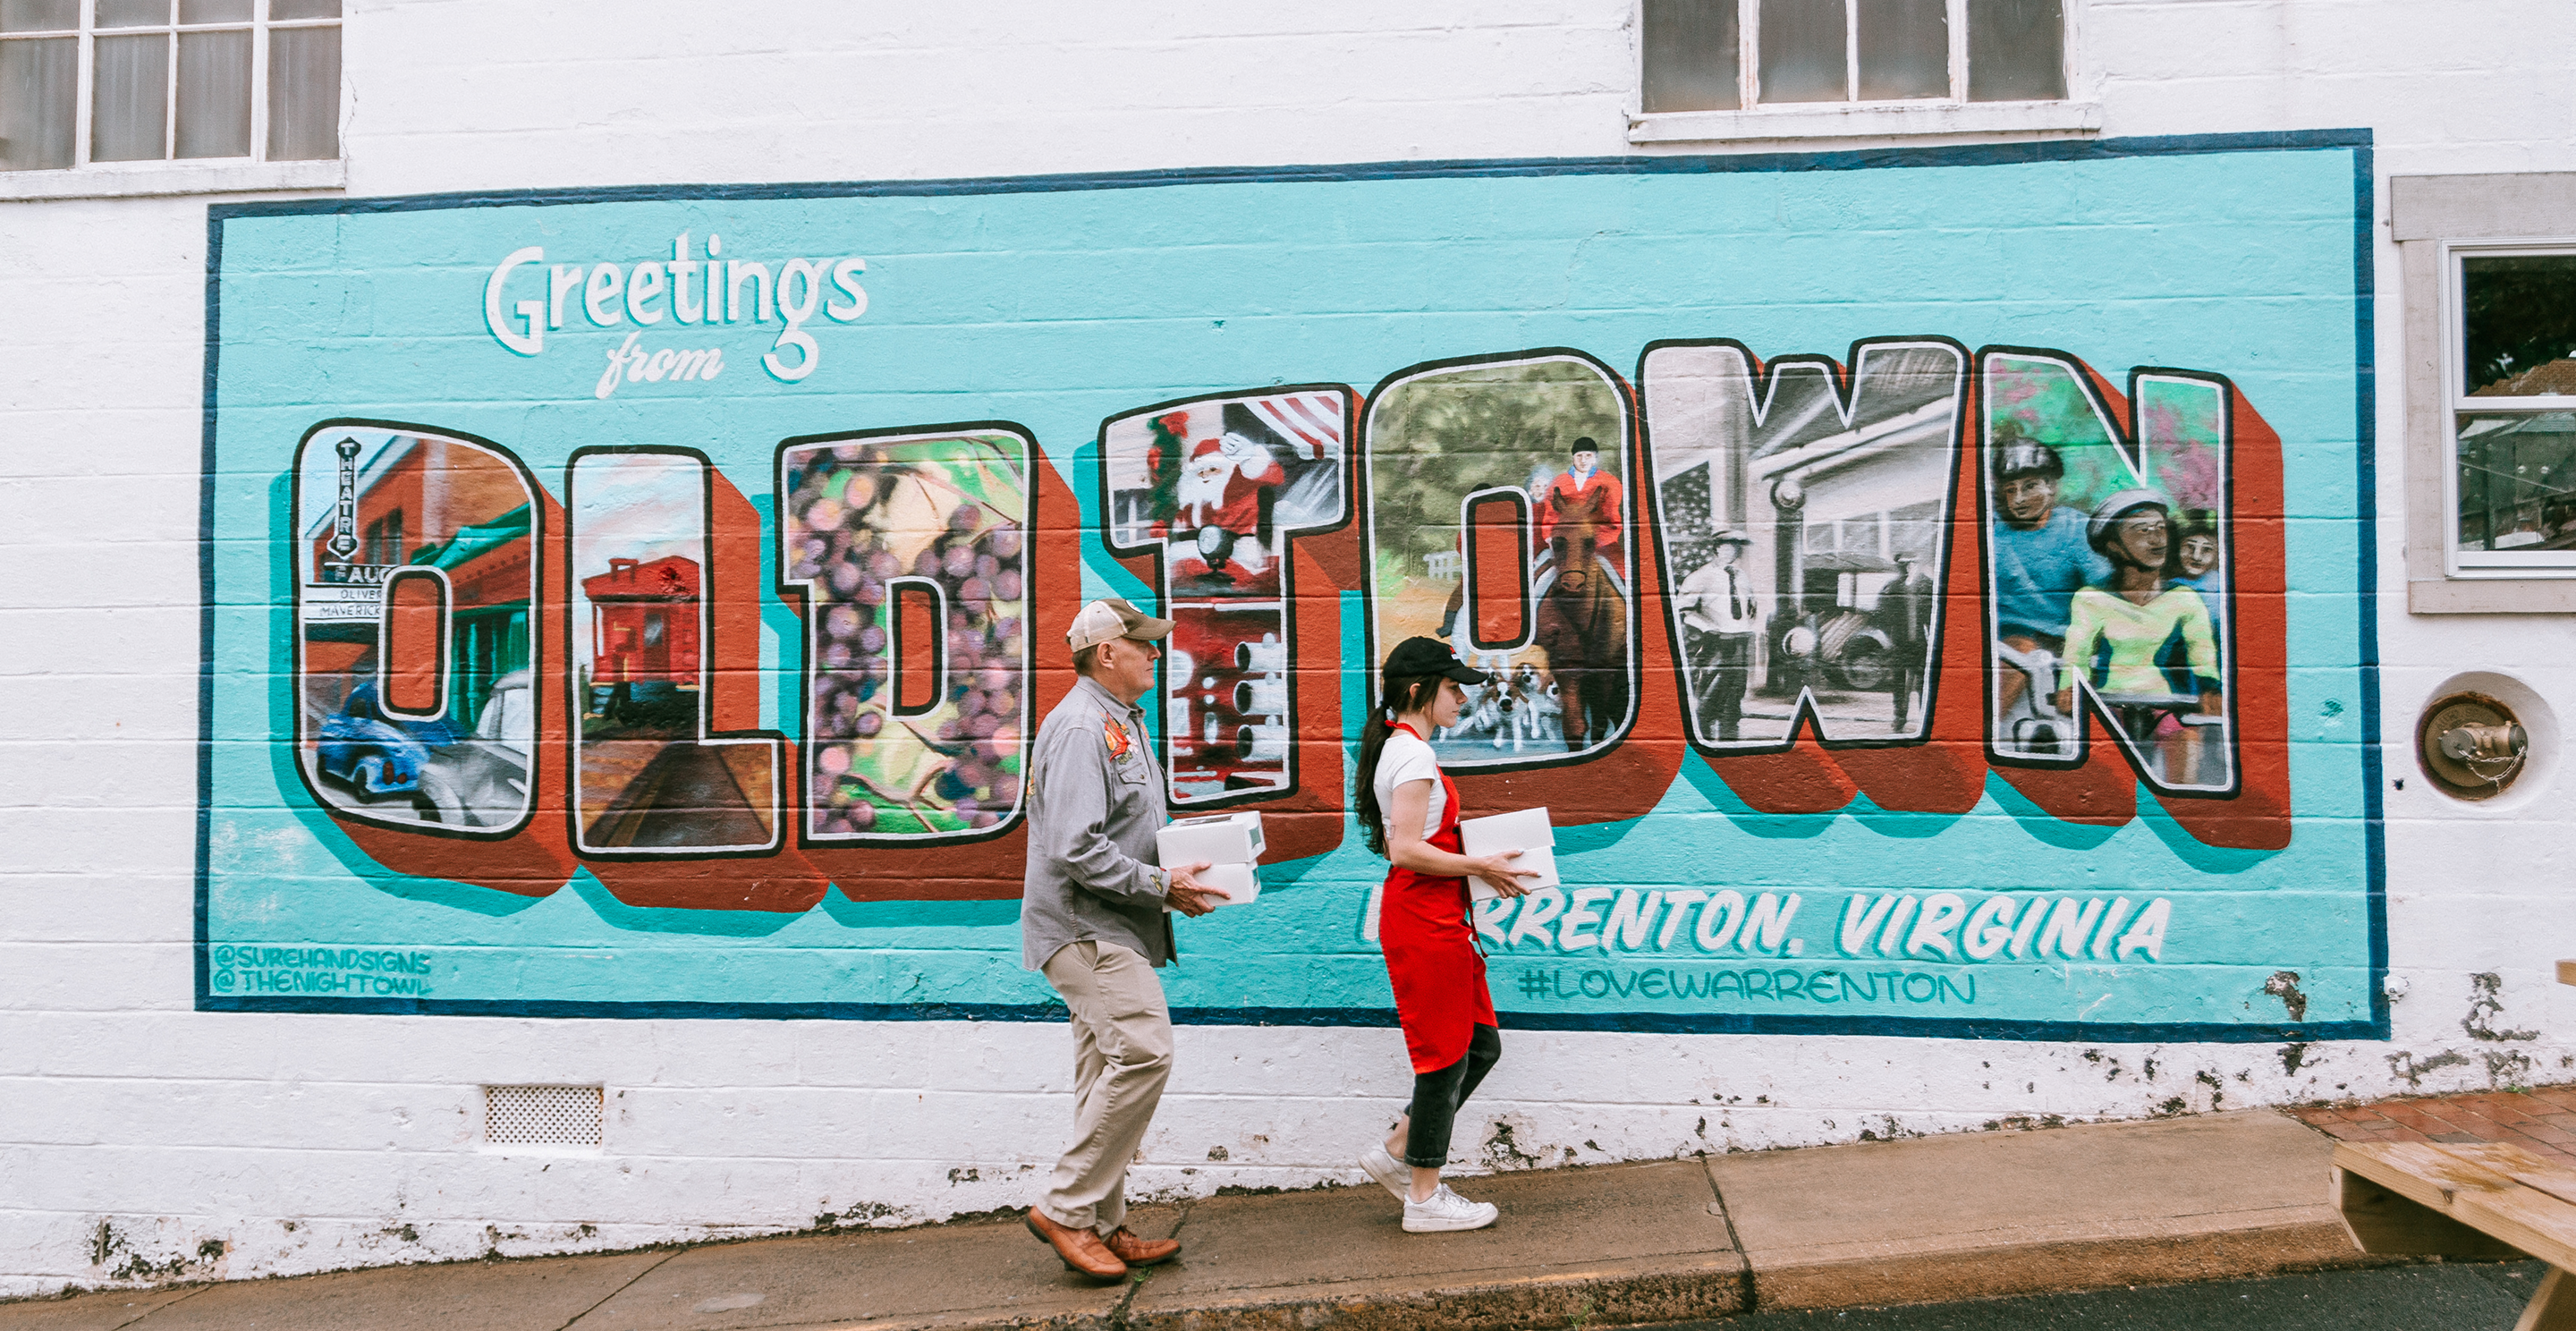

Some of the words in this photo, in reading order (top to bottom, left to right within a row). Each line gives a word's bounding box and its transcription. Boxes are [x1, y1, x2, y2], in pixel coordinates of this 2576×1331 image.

[485, 232, 869, 383] Greetings
[596, 330, 724, 399] from
[336, 443, 355, 551] THEATRE
[292, 419, 1040, 857] OLD
[1097, 335, 2241, 801] TOWN
[340, 589, 382, 600] OLIVER
[1363, 885, 1803, 954] RRENTON,
[1841, 893, 2172, 960] VIRGINIA
[213, 944, 432, 975] @SUREHANDSIGNS
[1518, 966, 1976, 1005] #LOVEWARRENTON
